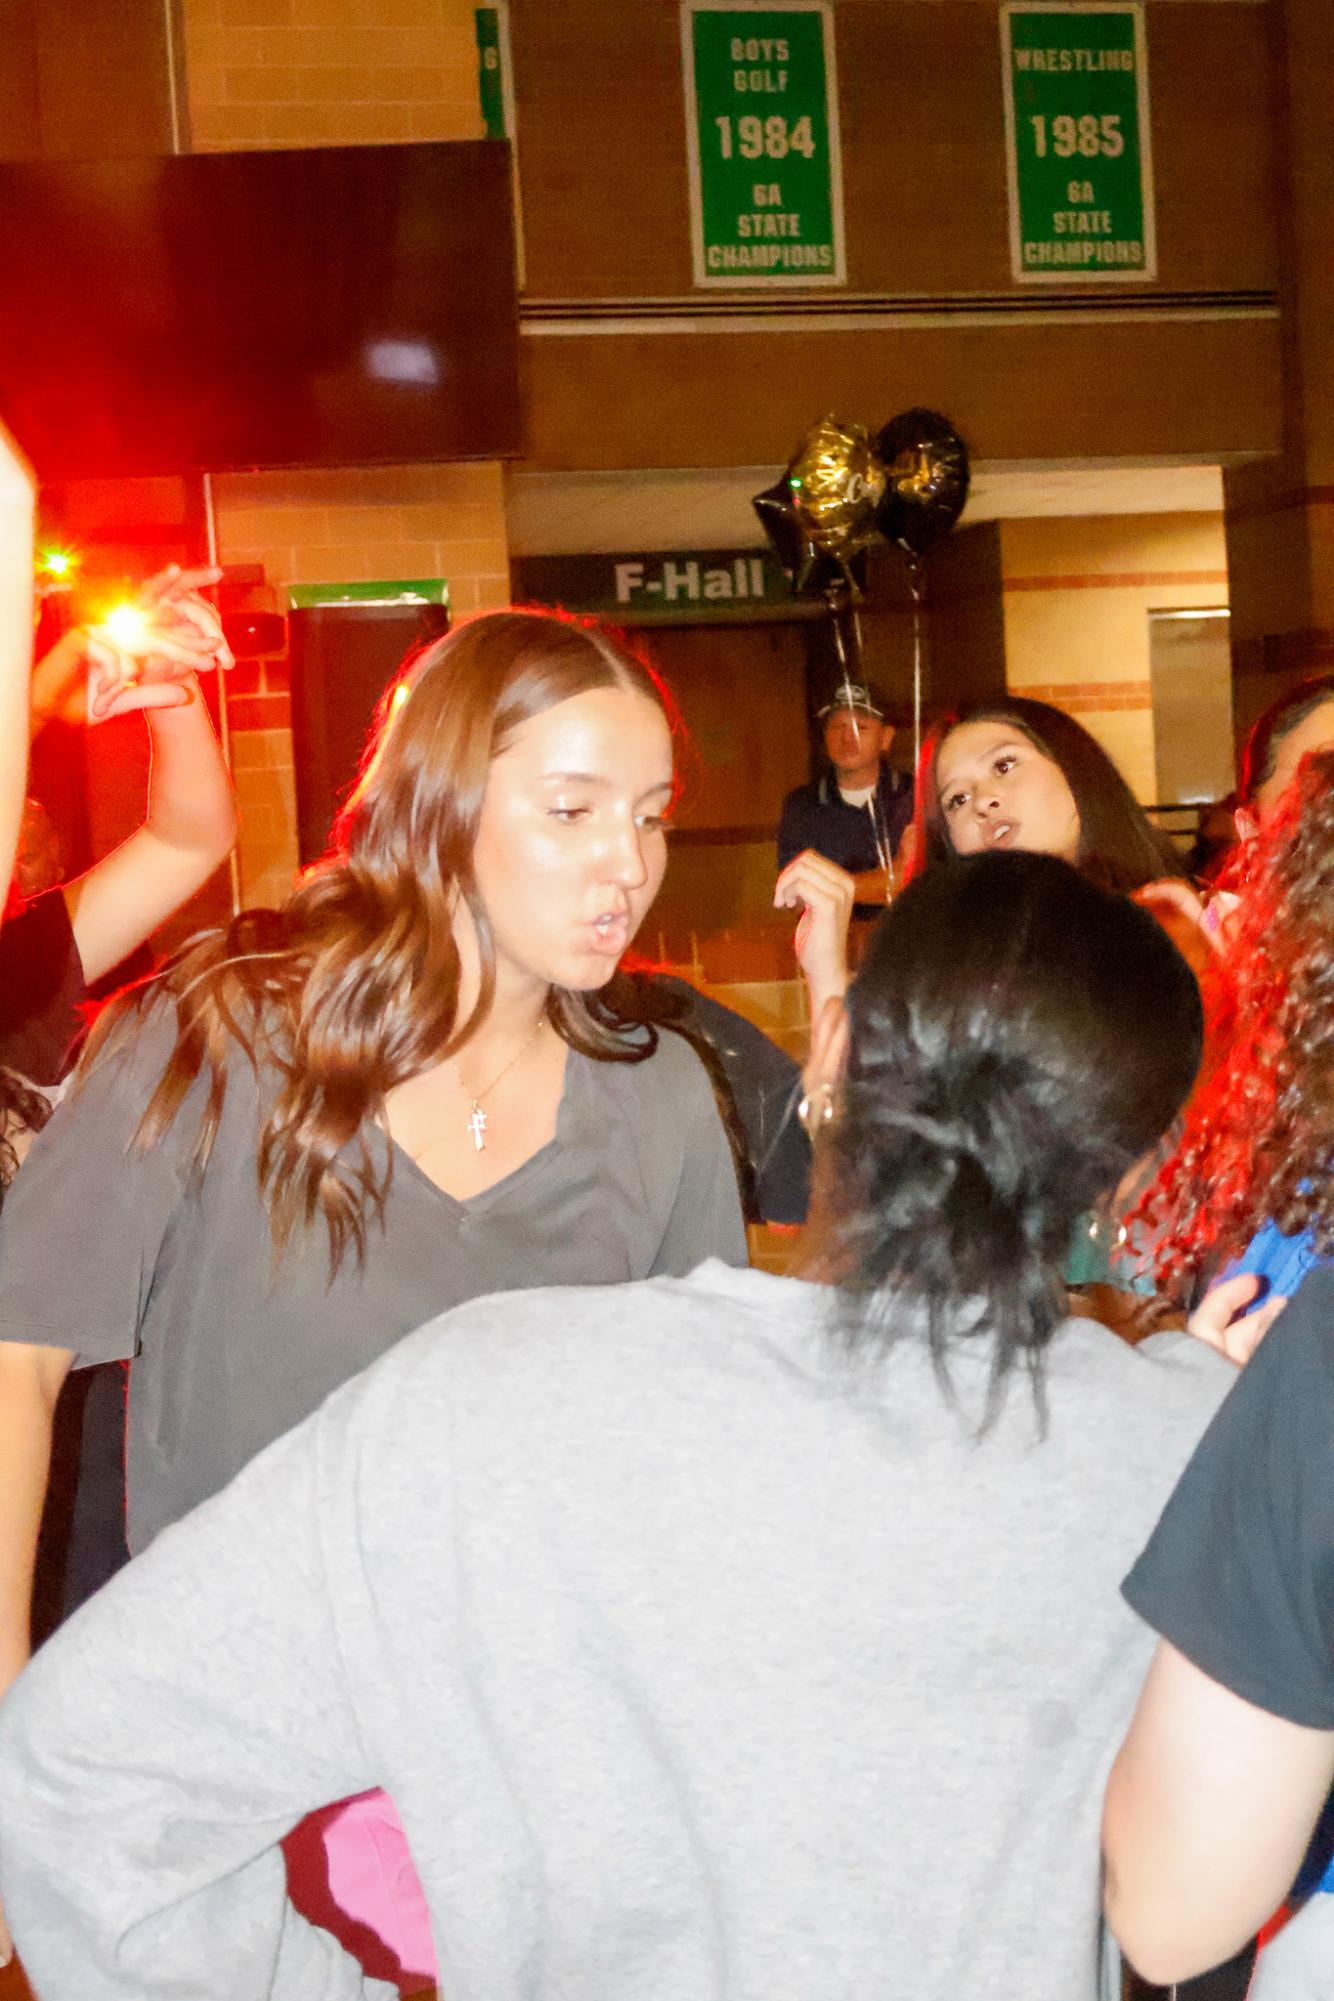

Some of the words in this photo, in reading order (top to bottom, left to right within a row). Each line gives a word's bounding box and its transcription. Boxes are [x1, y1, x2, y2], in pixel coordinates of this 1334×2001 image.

[1014, 49, 1133, 71] WRESTLING
[715, 115, 816, 160] 1984
[1029, 114, 1124, 158] 1985
[738, 213, 800, 237] STATE
[1053, 210, 1112, 234] STATE
[708, 244, 832, 268] CHAMPIONS
[1023, 240, 1142, 264] CHAMPIONS
[614, 559, 765, 603] F-Hall
